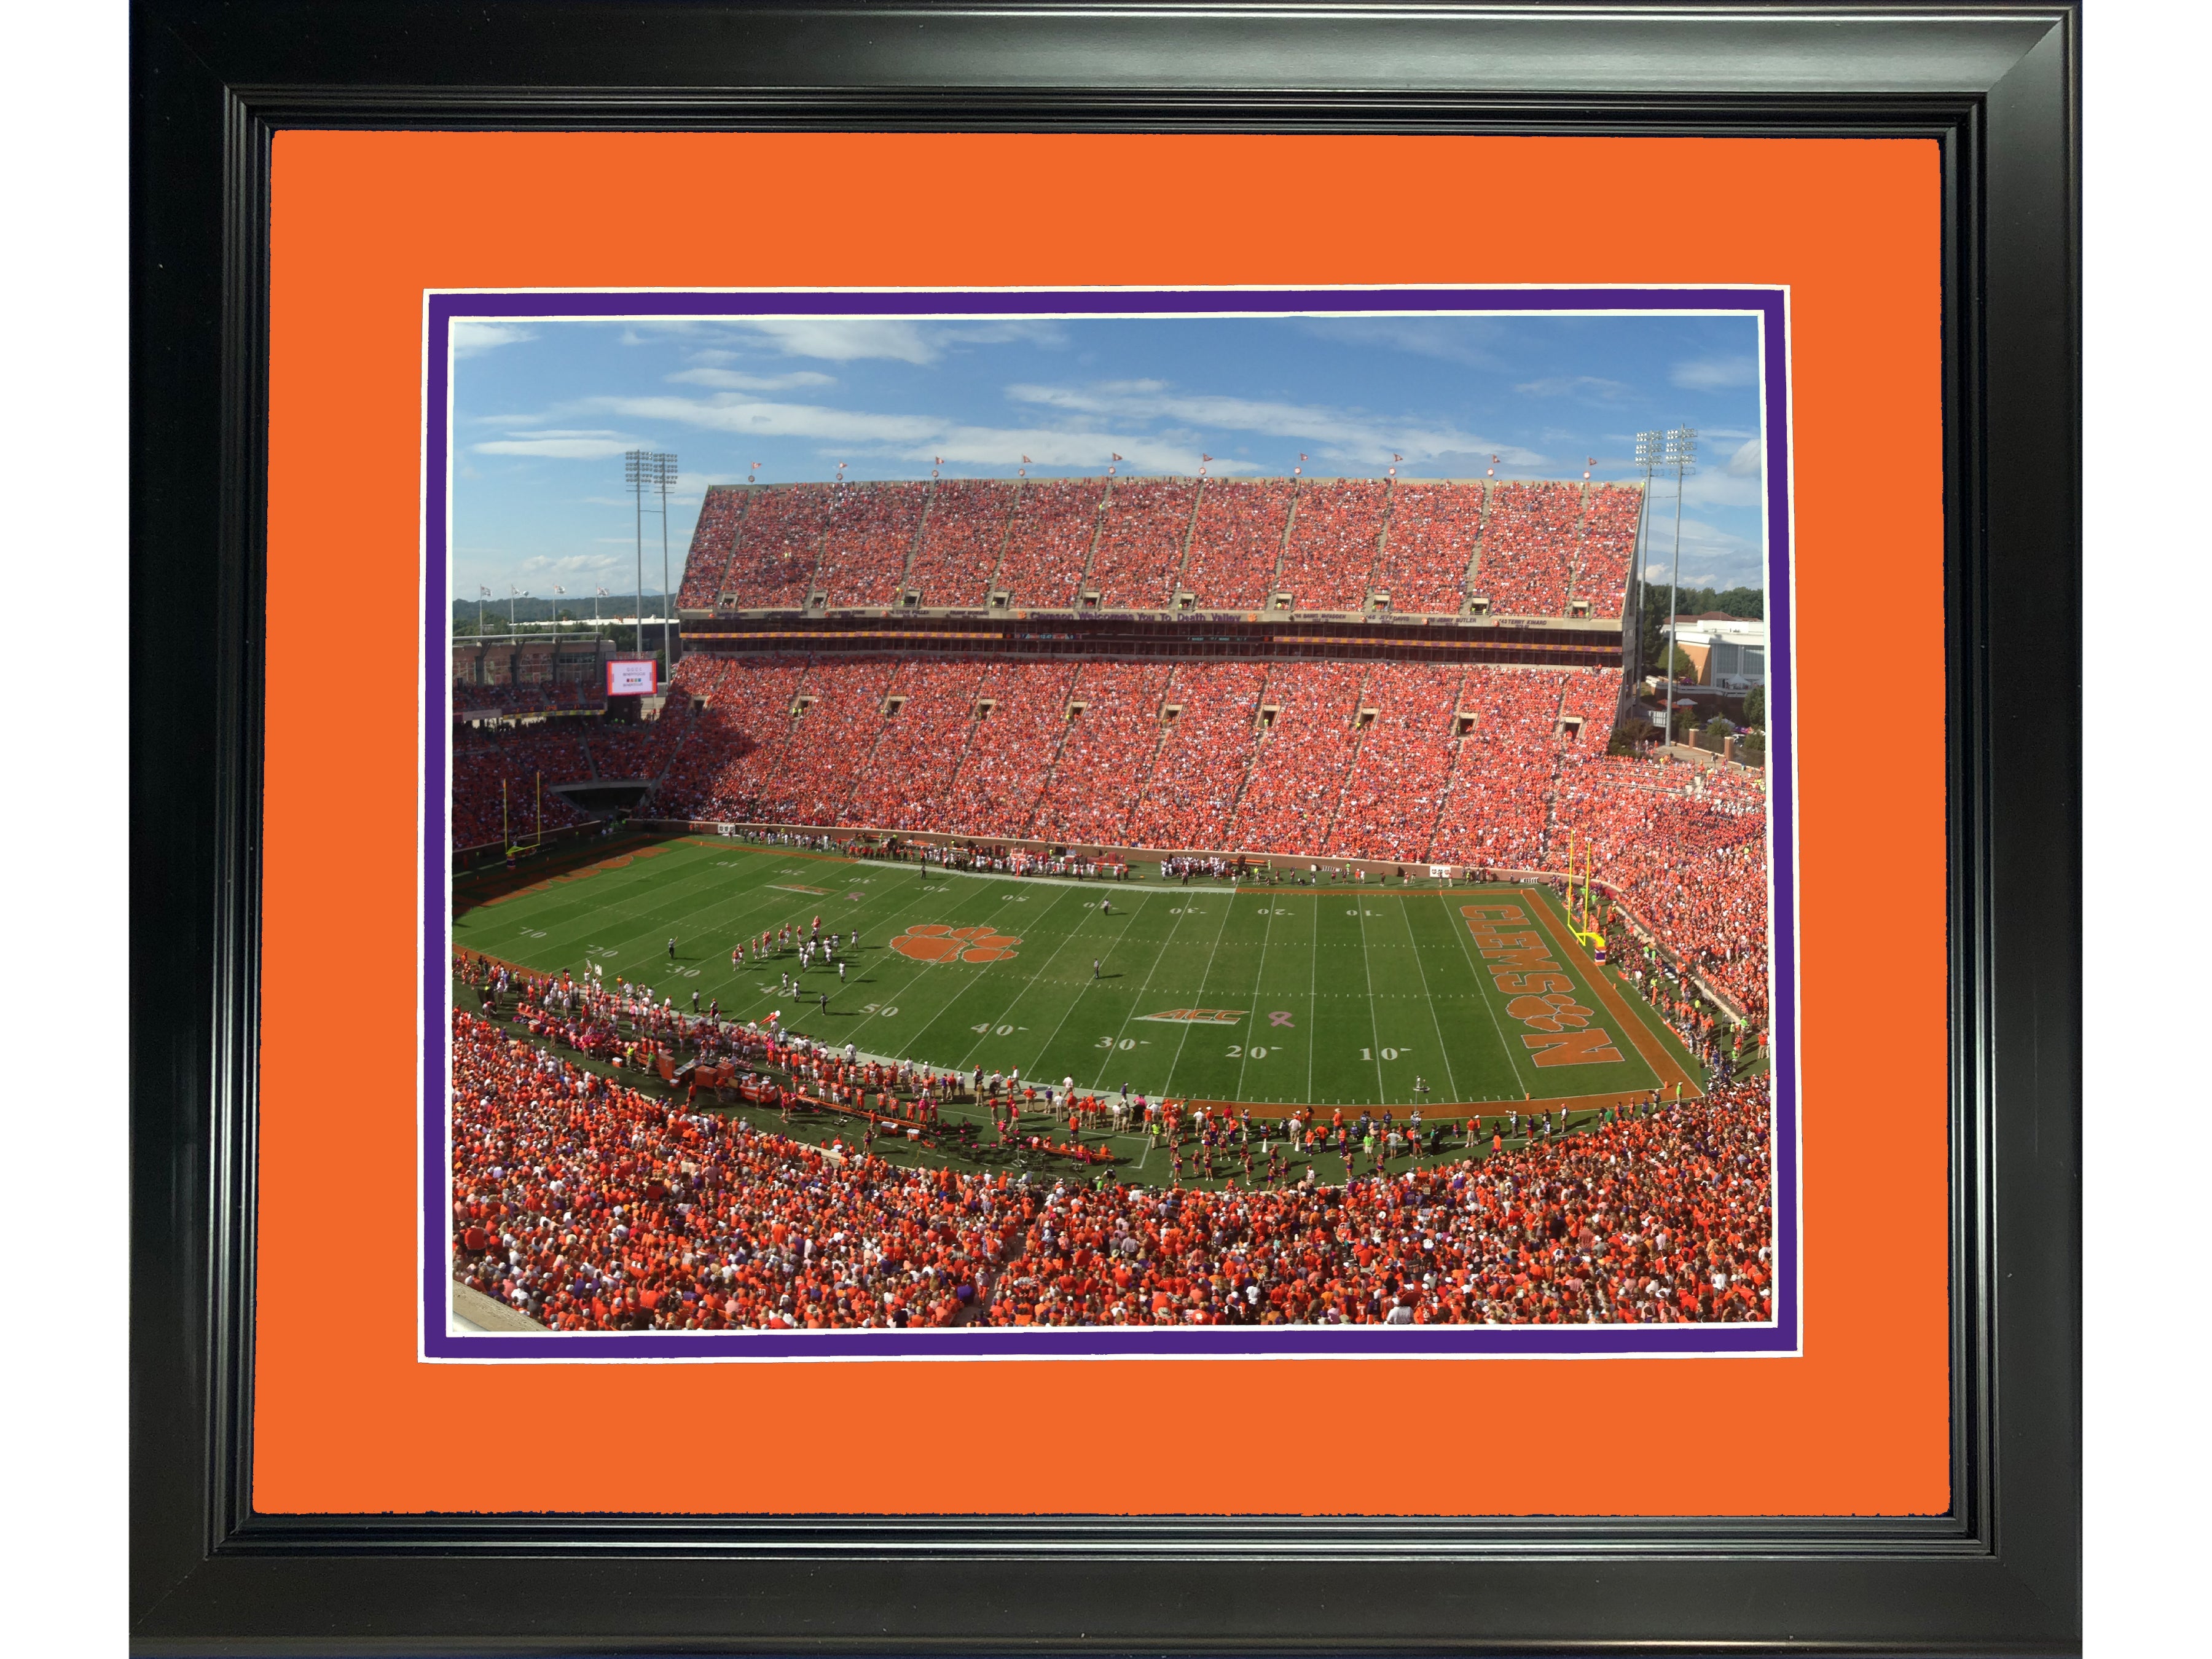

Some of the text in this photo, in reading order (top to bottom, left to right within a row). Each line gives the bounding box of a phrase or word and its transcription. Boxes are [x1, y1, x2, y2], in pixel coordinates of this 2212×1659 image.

[1078, 611, 1135, 621] Welcomes
[1137, 613, 1155, 622] You
[1159, 613, 1172, 622] To
[1177, 613, 1206, 622] Death
[1210, 613, 1242, 624] Valley
[520, 928, 547, 938] 10
[585, 946, 619, 957] 20
[665, 965, 700, 977] 30
[858, 1003, 899, 1017] 50
[1145, 1008, 1252, 1023] ACC
[970, 1022, 1014, 1036] 40
[1094, 1036, 1136, 1051] 30
[1225, 1045, 1268, 1059] 20
[1359, 1048, 1398, 1061] 10
